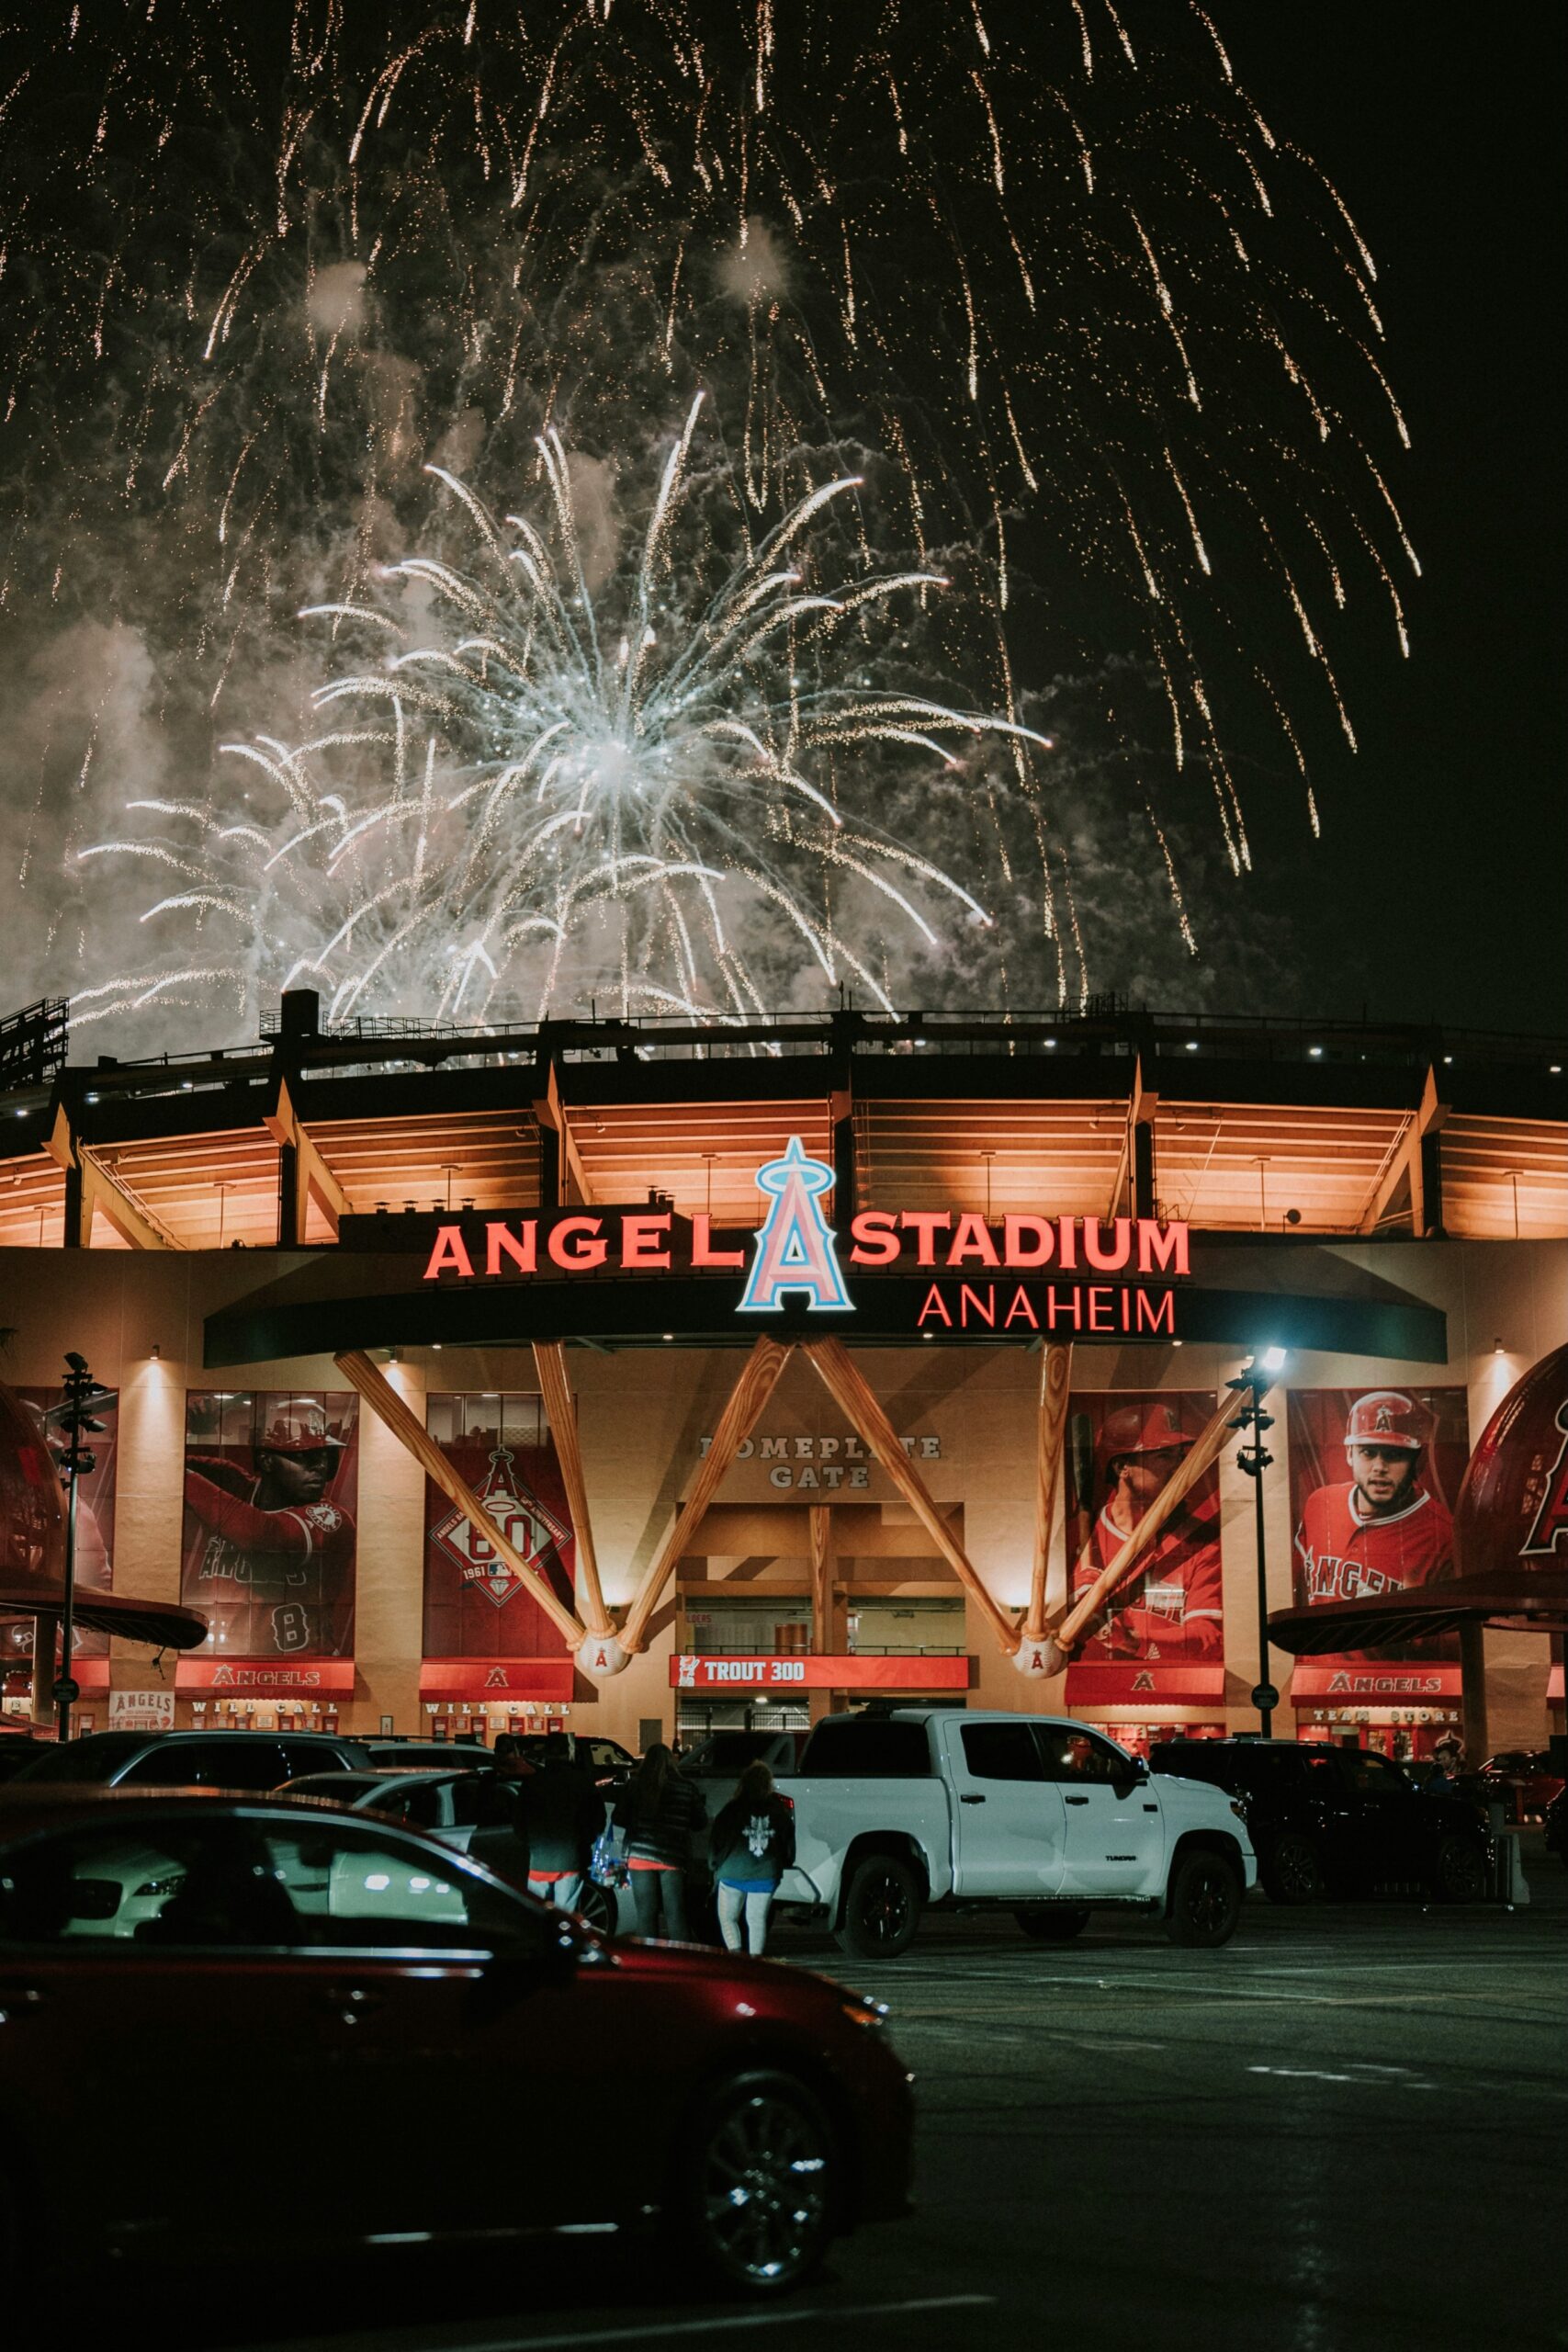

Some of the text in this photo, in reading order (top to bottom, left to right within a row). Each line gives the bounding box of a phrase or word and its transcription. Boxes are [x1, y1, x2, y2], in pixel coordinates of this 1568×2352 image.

[423, 1212, 745, 1279] ANGEL
[850, 1210, 1191, 1275] STADIUM
[917, 1283, 1176, 1334] ANAHEIM
[769, 1466, 868, 1488] GATE
[463, 1566, 485, 1580] 1961
[271, 1602, 310, 1653] 8
[705, 1661, 805, 1681] TROUT 300
[116, 1694, 171, 1713] ANGELS
[192, 1702, 338, 1713] WILL CALL
[425, 1703, 570, 1715] WILL CALL
[1314, 1710, 1459, 1722] TEAM STORE
